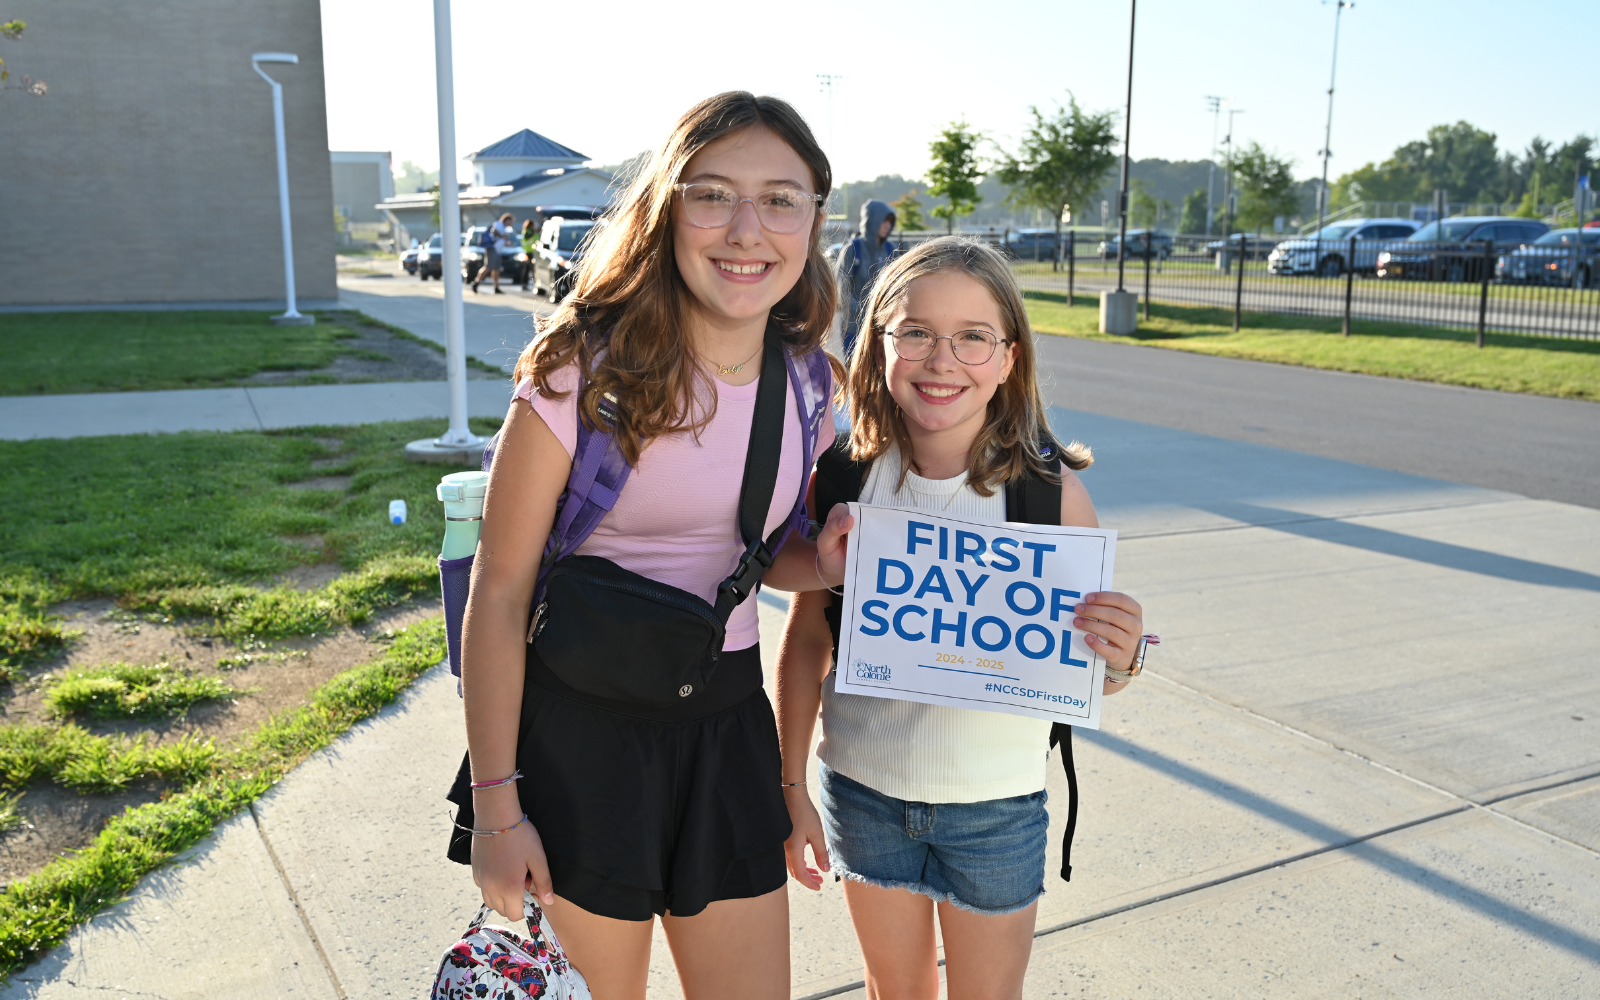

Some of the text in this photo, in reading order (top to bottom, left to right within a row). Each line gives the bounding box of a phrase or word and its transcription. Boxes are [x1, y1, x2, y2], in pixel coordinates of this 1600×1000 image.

[907, 520, 1057, 578] FIRST
[876, 557, 1081, 622] DAY OF
[859, 599, 1088, 669] SCHOOL
[863, 662, 891, 675] North
[936, 653, 965, 665] 2024
[976, 657, 1004, 670] 2025
[856, 669, 891, 682] Colonie
[985, 682, 1087, 709] #NCCSDFirstDay
